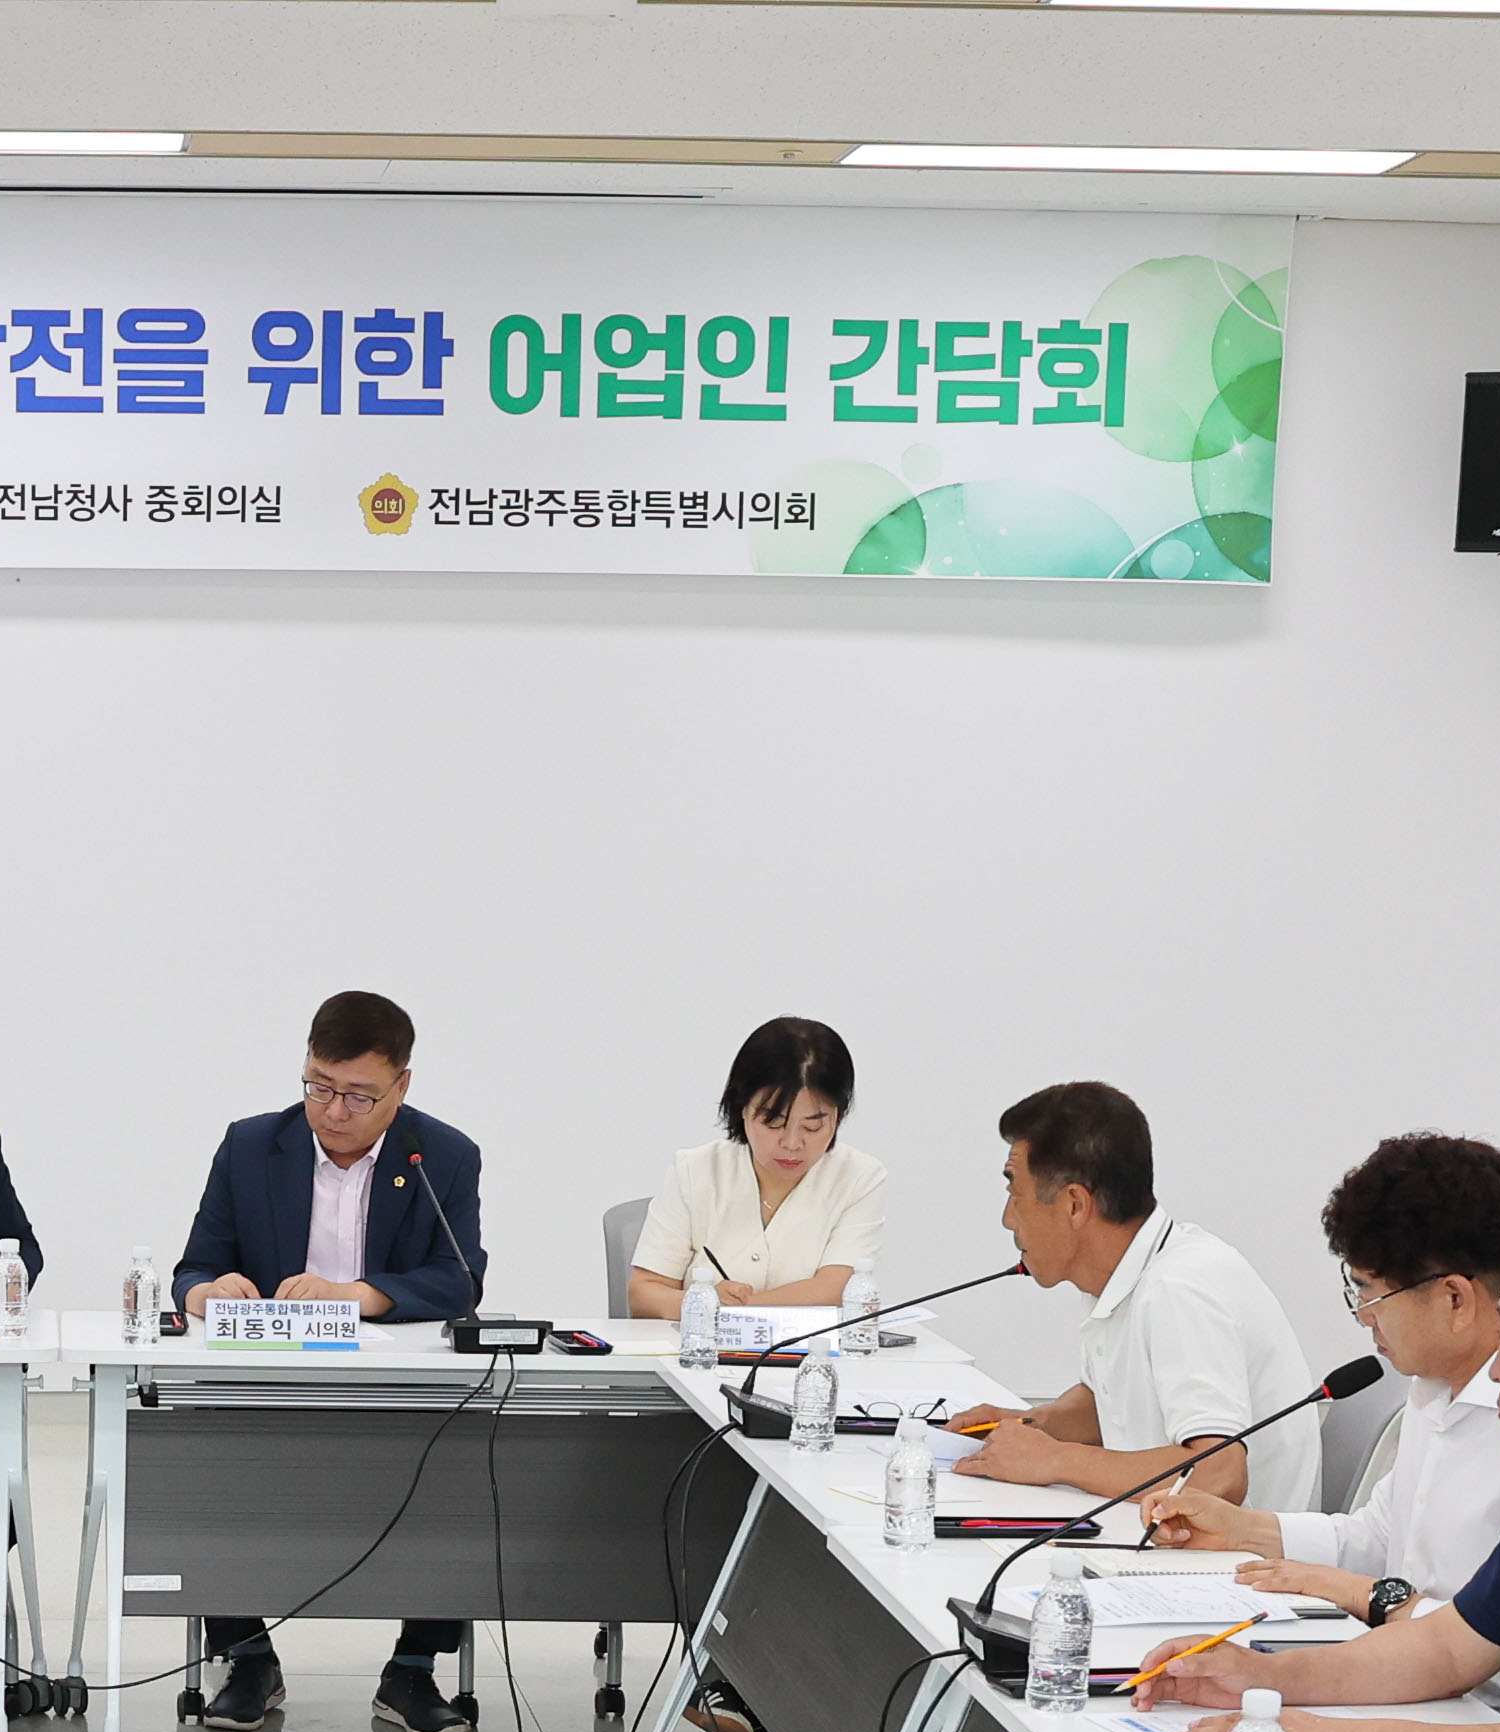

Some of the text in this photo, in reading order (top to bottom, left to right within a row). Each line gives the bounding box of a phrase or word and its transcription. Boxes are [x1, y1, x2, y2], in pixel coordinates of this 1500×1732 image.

[247, 308, 455, 416] 위한
[489, 313, 790, 422] 어업인
[829, 319, 1129, 428] 간담회
[144, 484, 281, 523] 중회의실
[373, 498, 403, 515] 의회
[428, 487, 816, 531] 전남광주통합특별시의회
[215, 1302, 352, 1316] 전남광주통합특별시의회
[216, 1318, 356, 1340] 최동익 시의원
